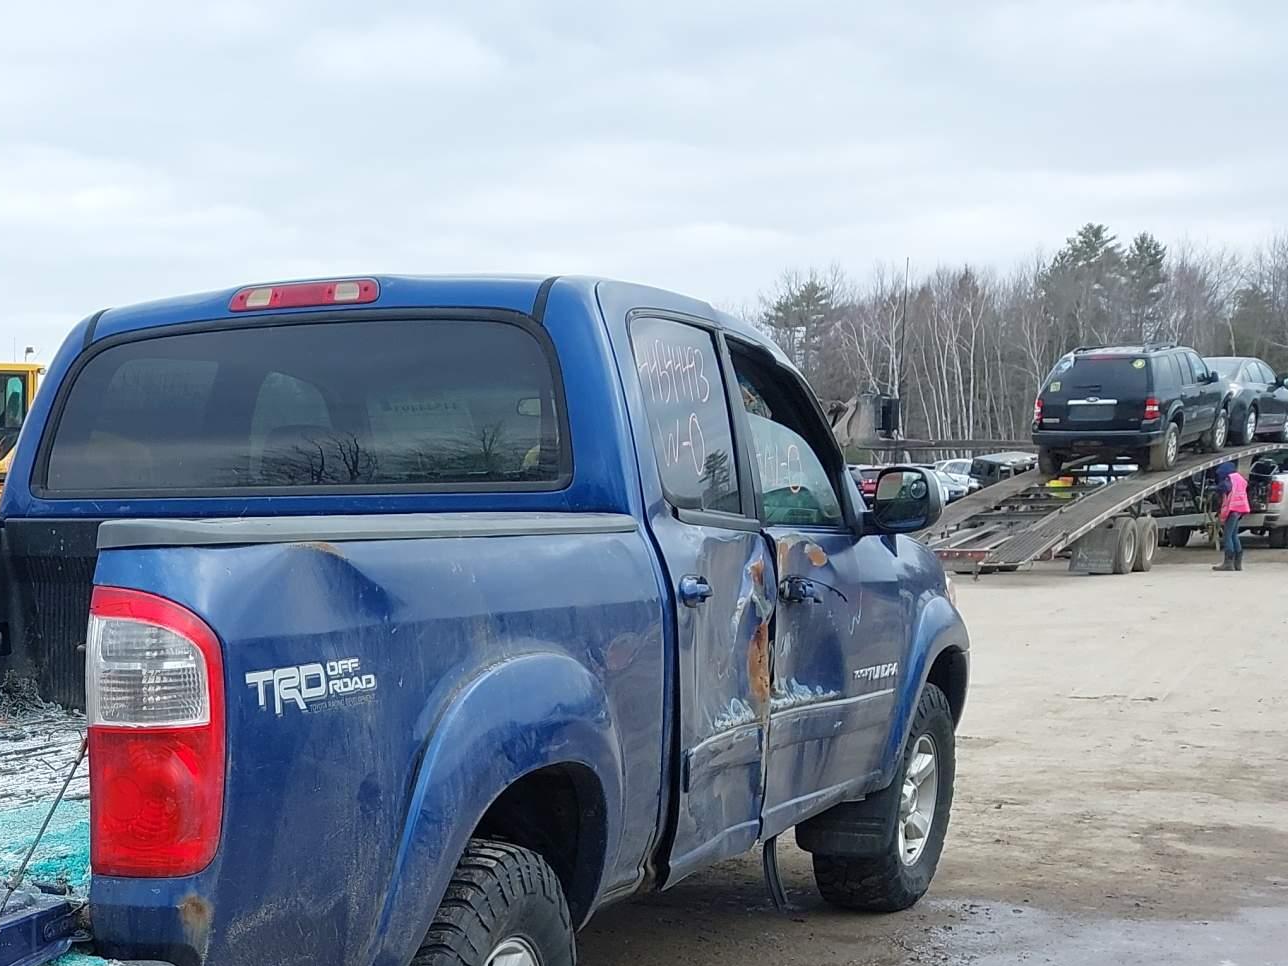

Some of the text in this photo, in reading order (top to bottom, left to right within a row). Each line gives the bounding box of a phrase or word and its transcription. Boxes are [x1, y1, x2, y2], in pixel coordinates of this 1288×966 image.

[245, 658, 360, 716] TRD OFF
[328, 674, 376, 695] ROAD
